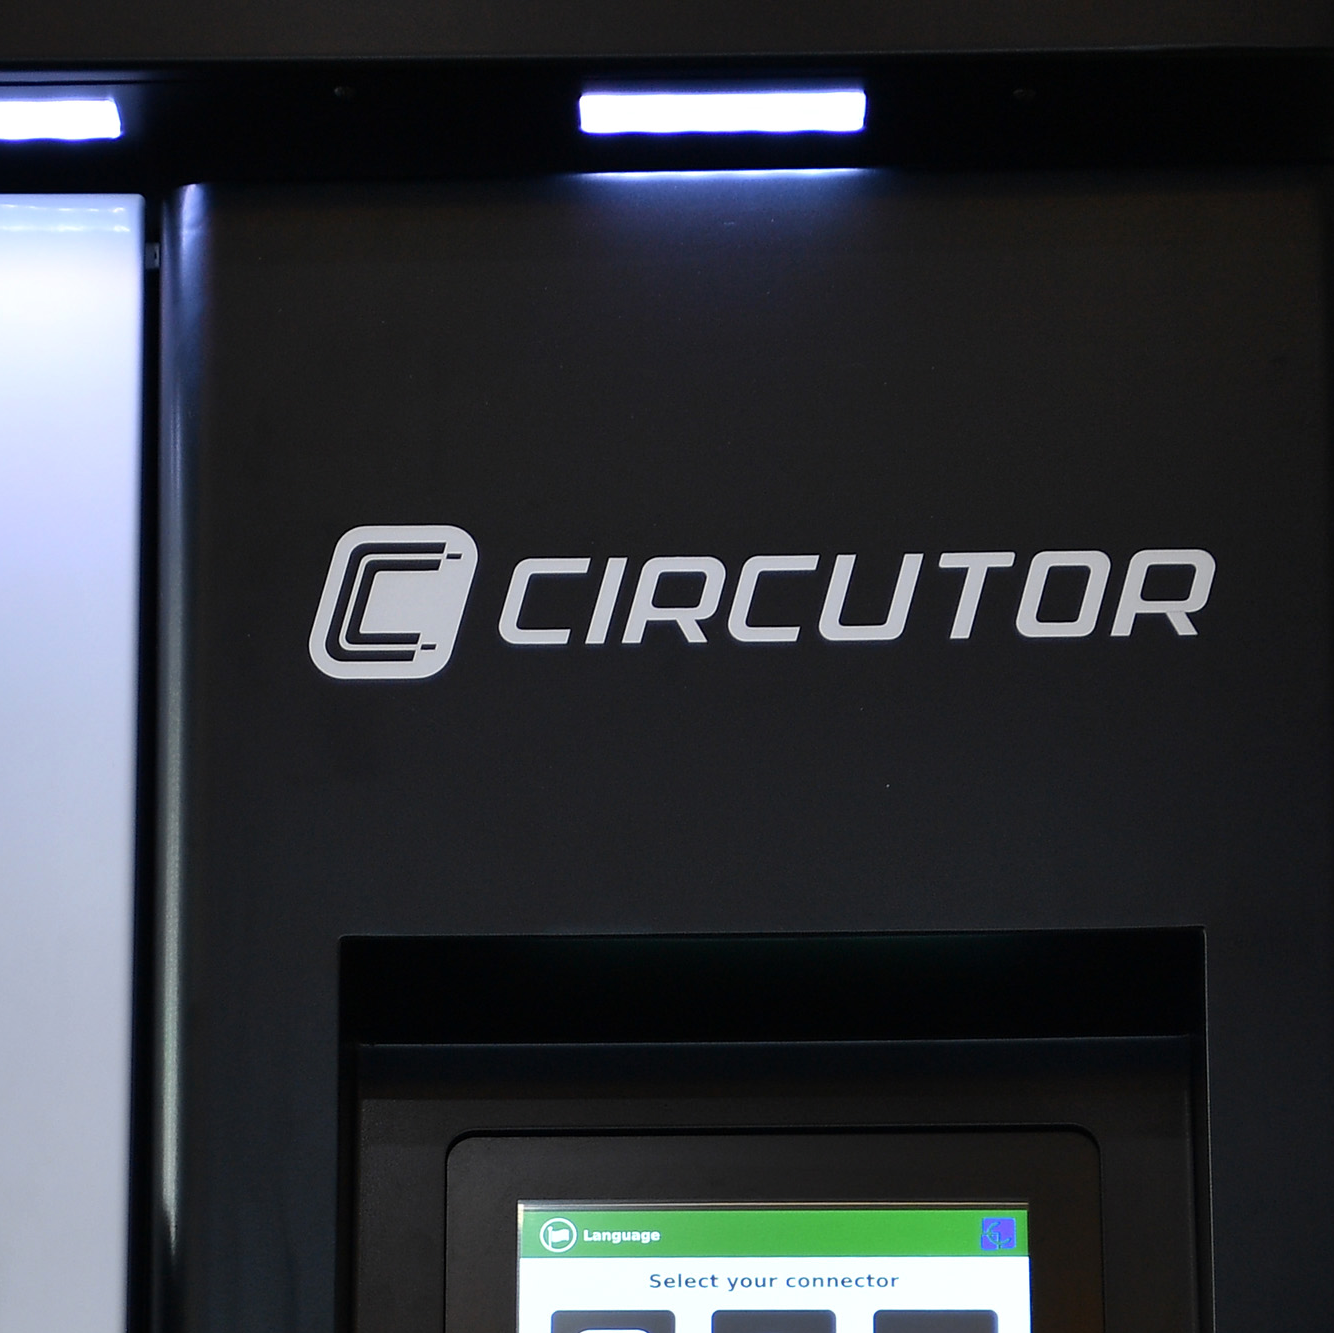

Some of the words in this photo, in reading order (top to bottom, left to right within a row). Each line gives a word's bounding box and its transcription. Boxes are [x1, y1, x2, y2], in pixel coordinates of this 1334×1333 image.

[499, 549, 1216, 644] CIRCUTOR
[583, 1228, 661, 1245] Language
[649, 1272, 719, 1289] Select
[727, 1276, 778, 1292] your
[785, 1273, 900, 1289] connector
